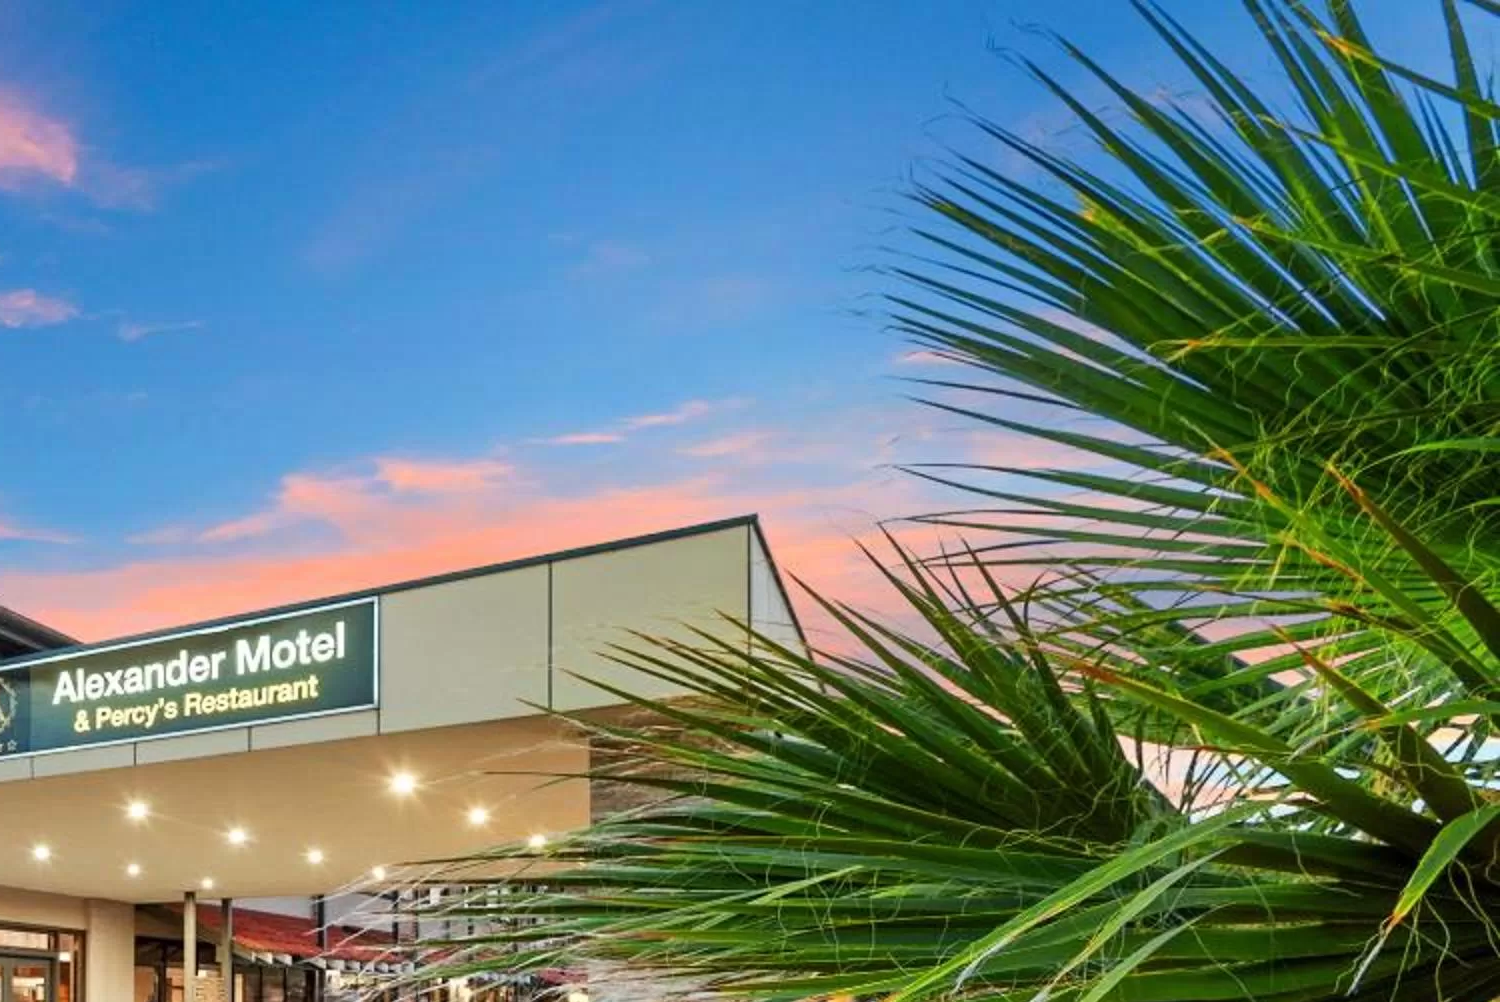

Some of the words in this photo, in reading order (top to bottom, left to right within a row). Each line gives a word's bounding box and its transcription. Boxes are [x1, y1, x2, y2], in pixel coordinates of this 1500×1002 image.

[52, 649, 227, 706] Alexander
[235, 620, 345, 675] Motel
[73, 709, 91, 733] &
[95, 697, 179, 730] Percy's
[183, 674, 319, 717] Restaurant
